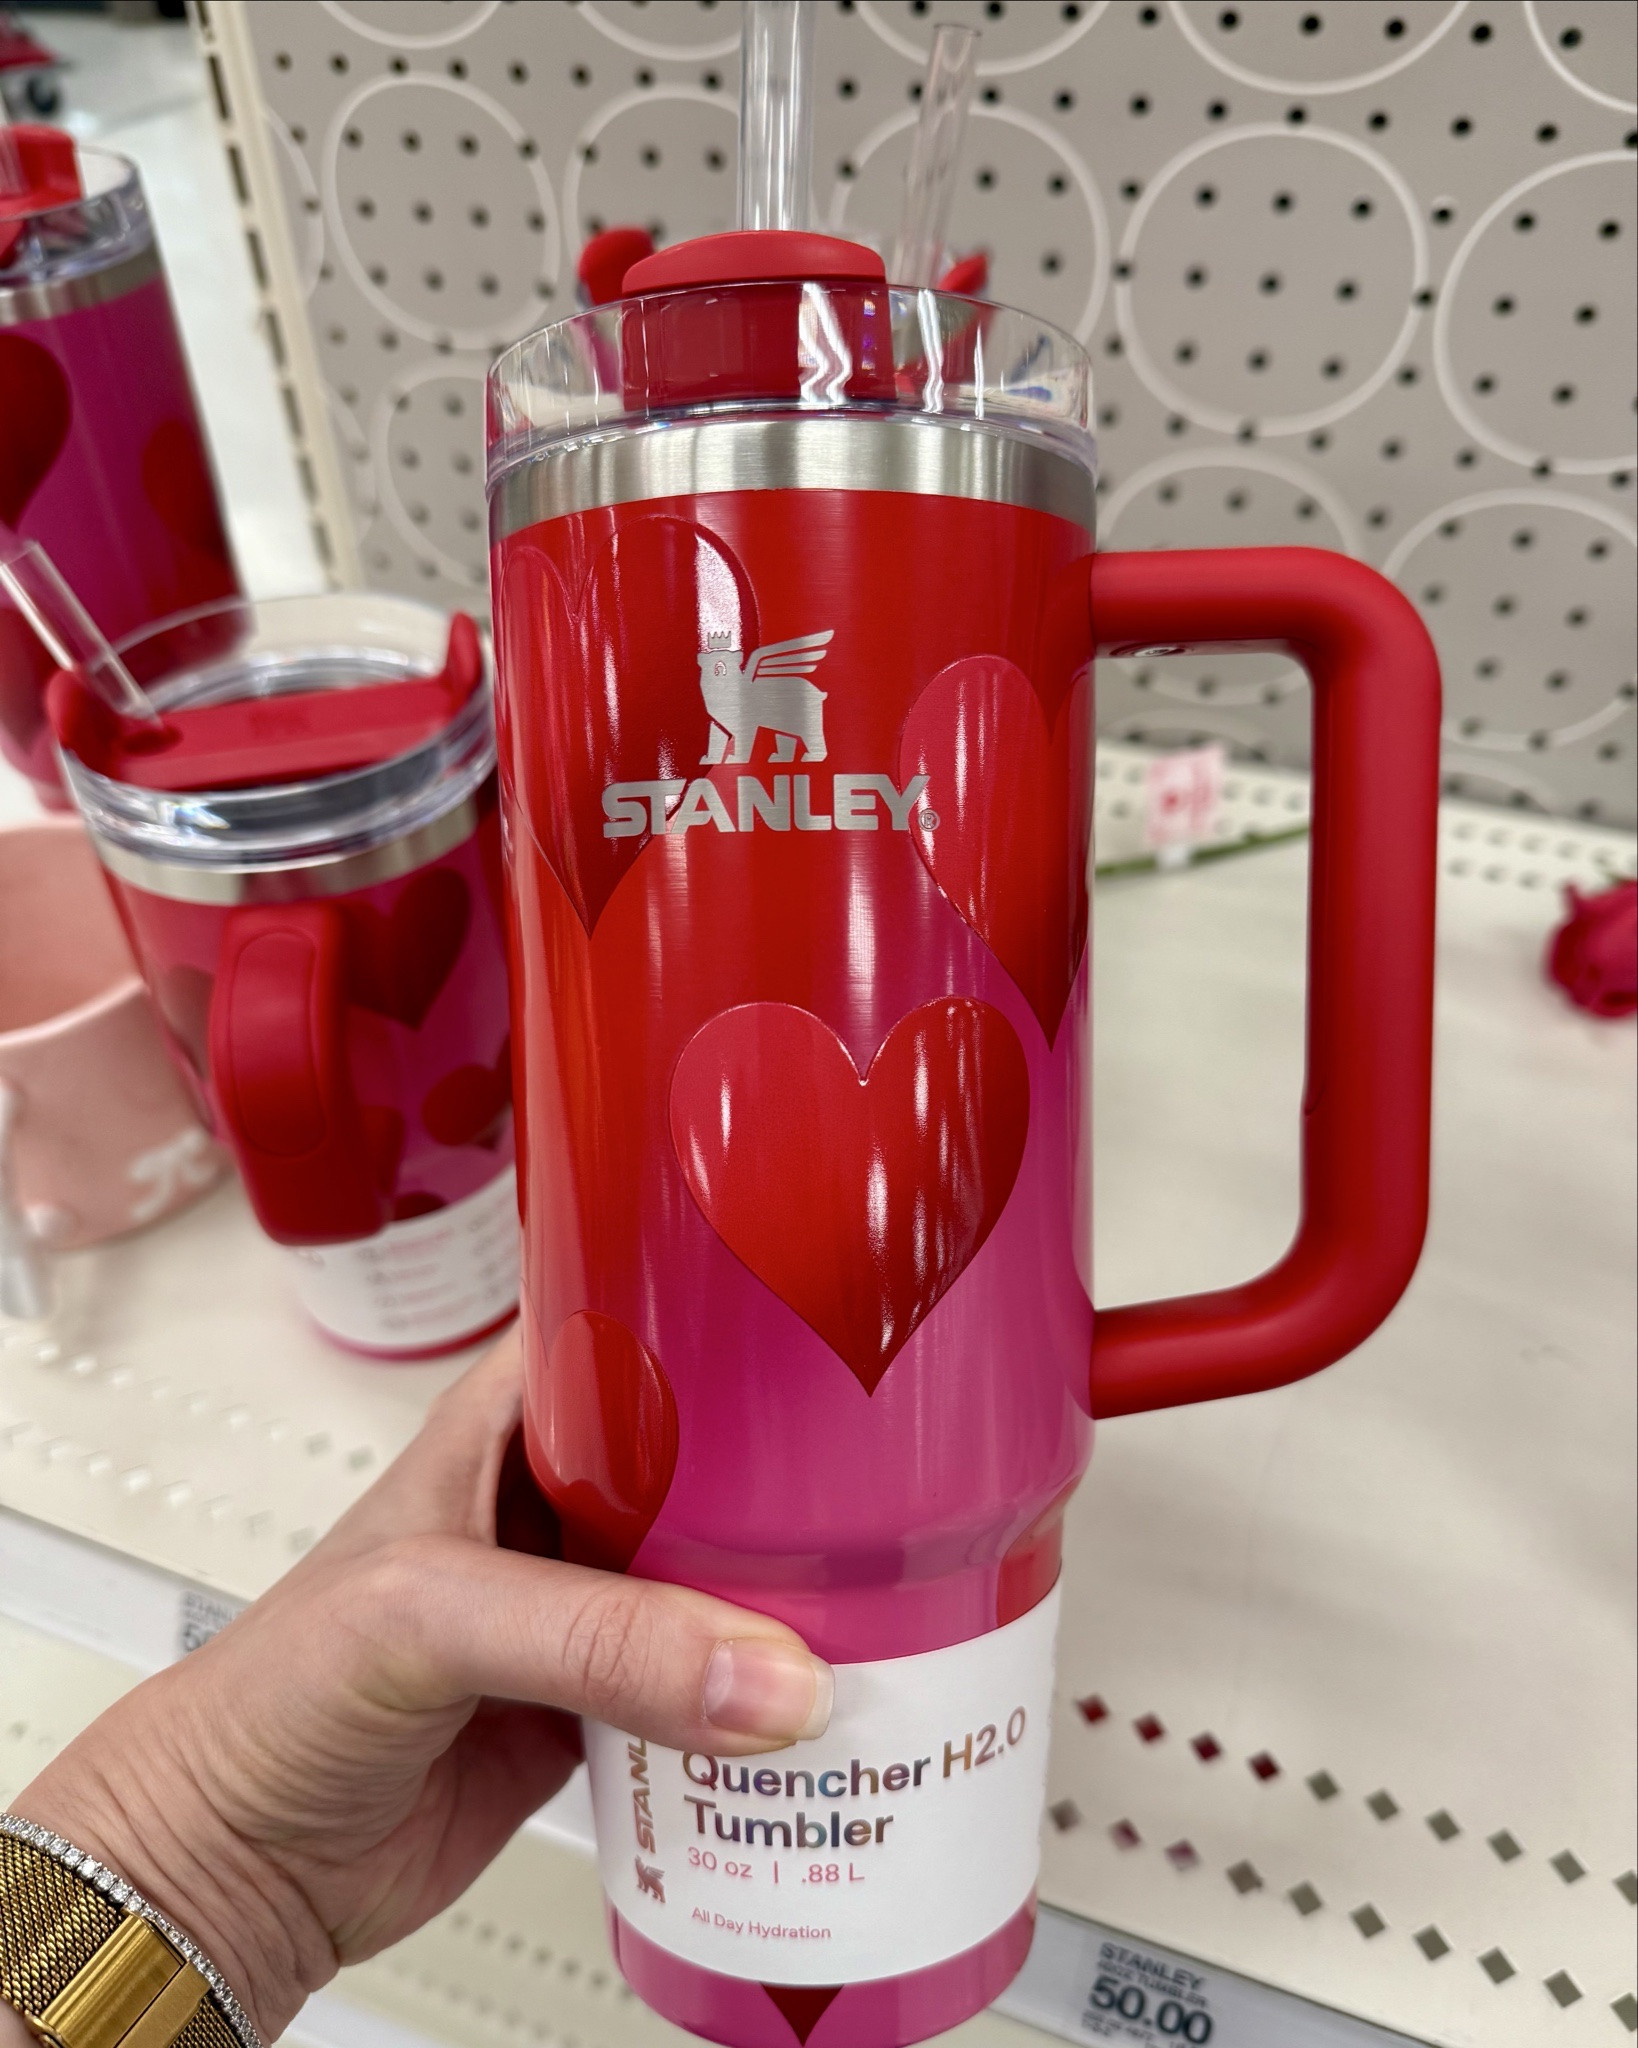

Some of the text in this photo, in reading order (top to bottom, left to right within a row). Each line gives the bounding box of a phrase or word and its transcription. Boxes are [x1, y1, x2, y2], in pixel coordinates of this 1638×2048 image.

[682, 1705, 1026, 1798] Quencher H2.0
[627, 1737, 656, 1854] STANL
[684, 1794, 894, 1848] Tumbler
[688, 1846, 718, 1872] 30
[724, 1861, 753, 1879] oz
[801, 1863, 841, 1884] .88
[849, 1862, 866, 1882] L
[691, 1906, 832, 1939] All Day Hydration
[1100, 1942, 1205, 1988] STANLEY
[1089, 1975, 1214, 2045] 50.00
